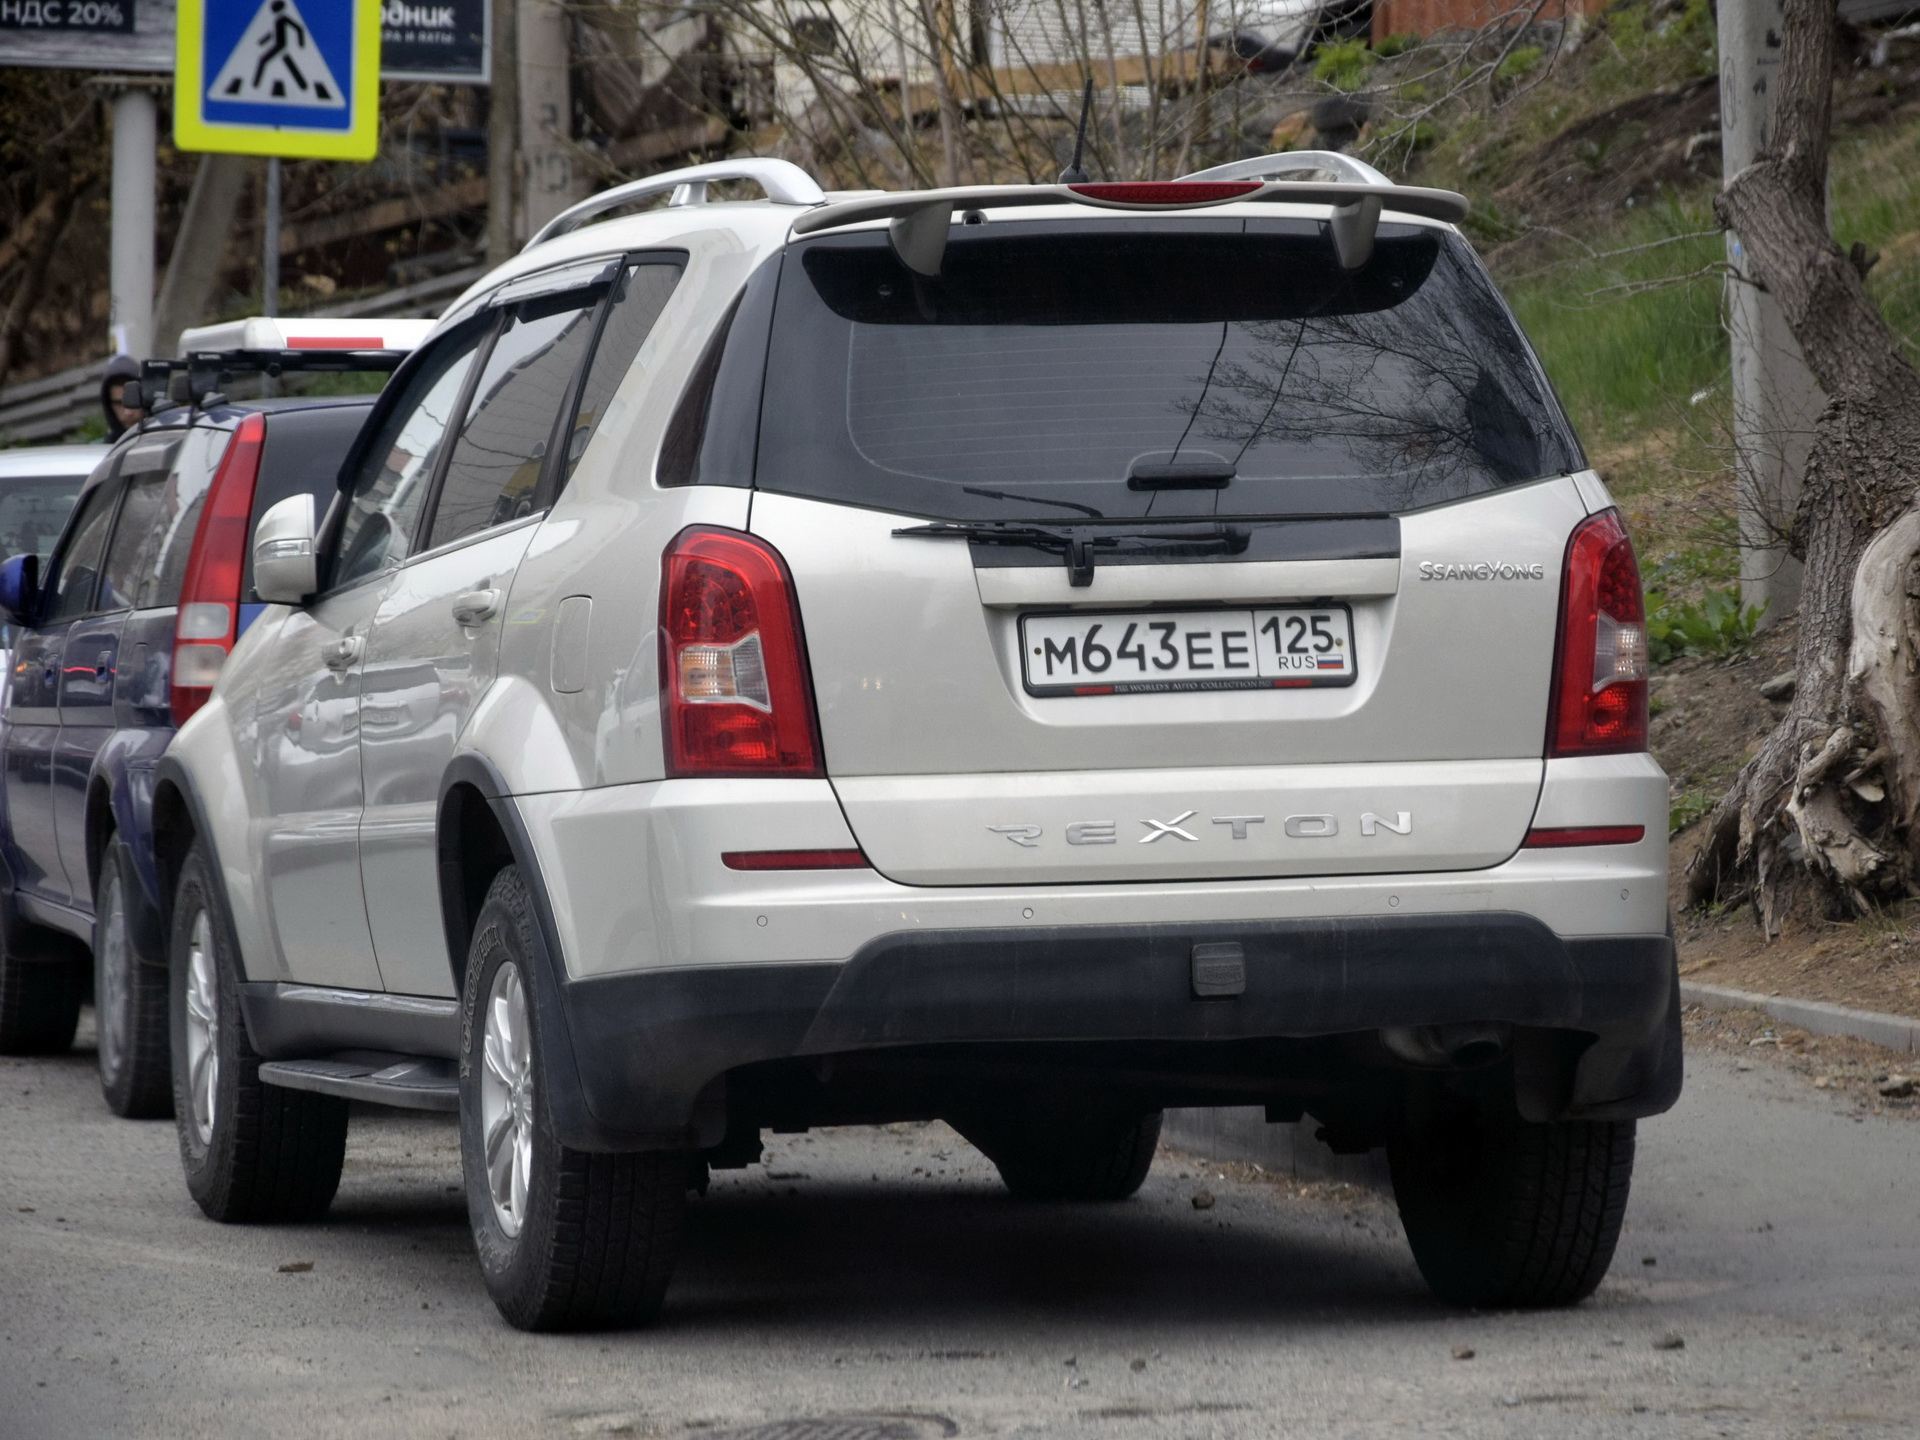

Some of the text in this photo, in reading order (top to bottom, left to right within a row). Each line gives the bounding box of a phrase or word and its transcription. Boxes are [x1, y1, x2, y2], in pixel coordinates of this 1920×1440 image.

[2, 1, 124, 26] НДС 20%
[1260, 615, 1335, 654] 125
[1278, 654, 1316, 670] RUS
[1171, 682, 1198, 690] AUTO
[1200, 680, 1258, 689] COLLECTION
[985, 810, 1413, 848] REXTON
[460, 925, 501, 1078] YOKOHAMA
